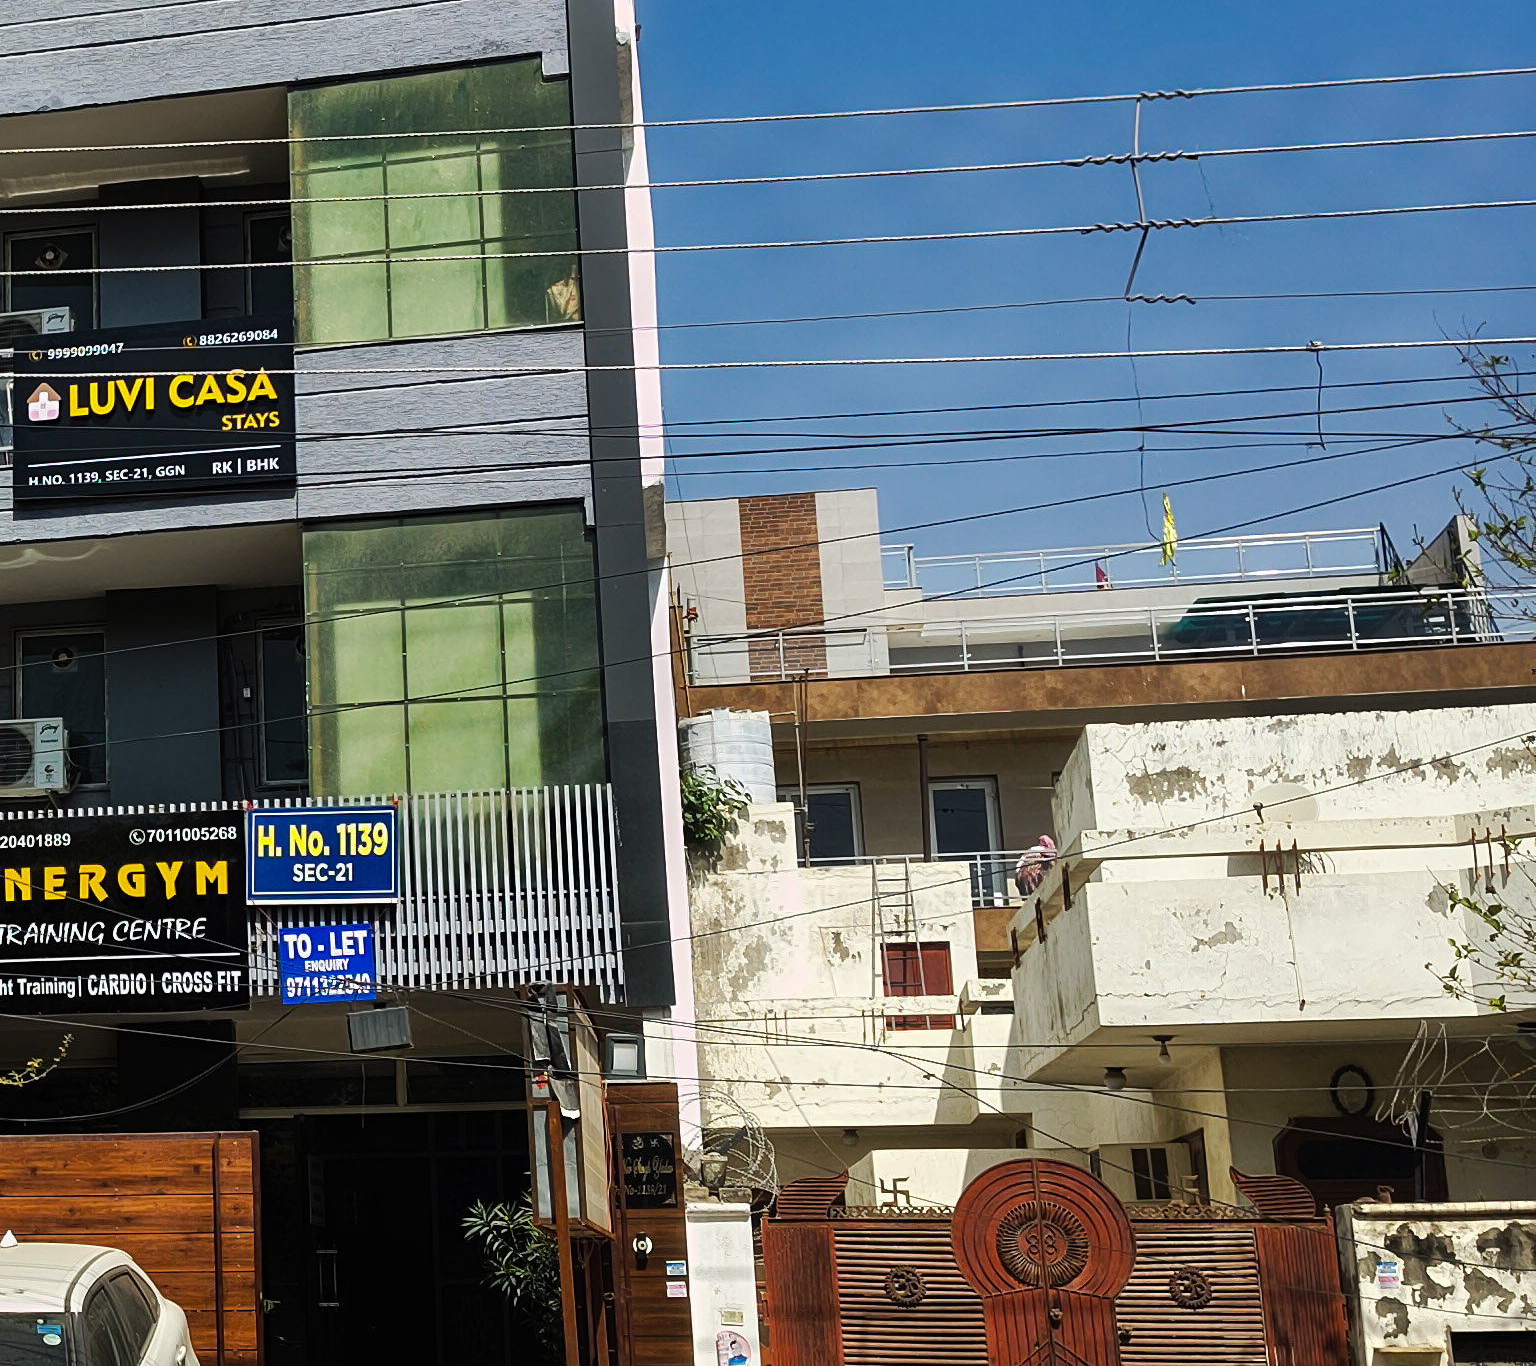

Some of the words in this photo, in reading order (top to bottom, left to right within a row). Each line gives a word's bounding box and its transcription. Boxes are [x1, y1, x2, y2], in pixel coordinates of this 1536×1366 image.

[199, 328, 278, 346] 8826269084
[69, 377, 155, 417] LUVI
[168, 366, 278, 408] CASA
[221, 411, 280, 431] STAYS
[155, 464, 186, 477] GGN
[212, 460, 233, 475] RK
[246, 457, 280, 472] BHK
[146, 826, 237, 843] 7011005268
[257, 824, 282, 857] H.
[289, 824, 330, 857] No.
[336, 822, 389, 856] 1139
[292, 862, 353, 882] SEC-21
[112, 917, 207, 942] CENTRE
[283, 933, 312, 959] TO
[329, 930, 368, 956] LET
[304, 958, 350, 972] ENQUIRY
[87, 972, 147, 995] CARDIO
[161, 971, 213, 994] CROSS
[217, 970, 241, 993] FIT
